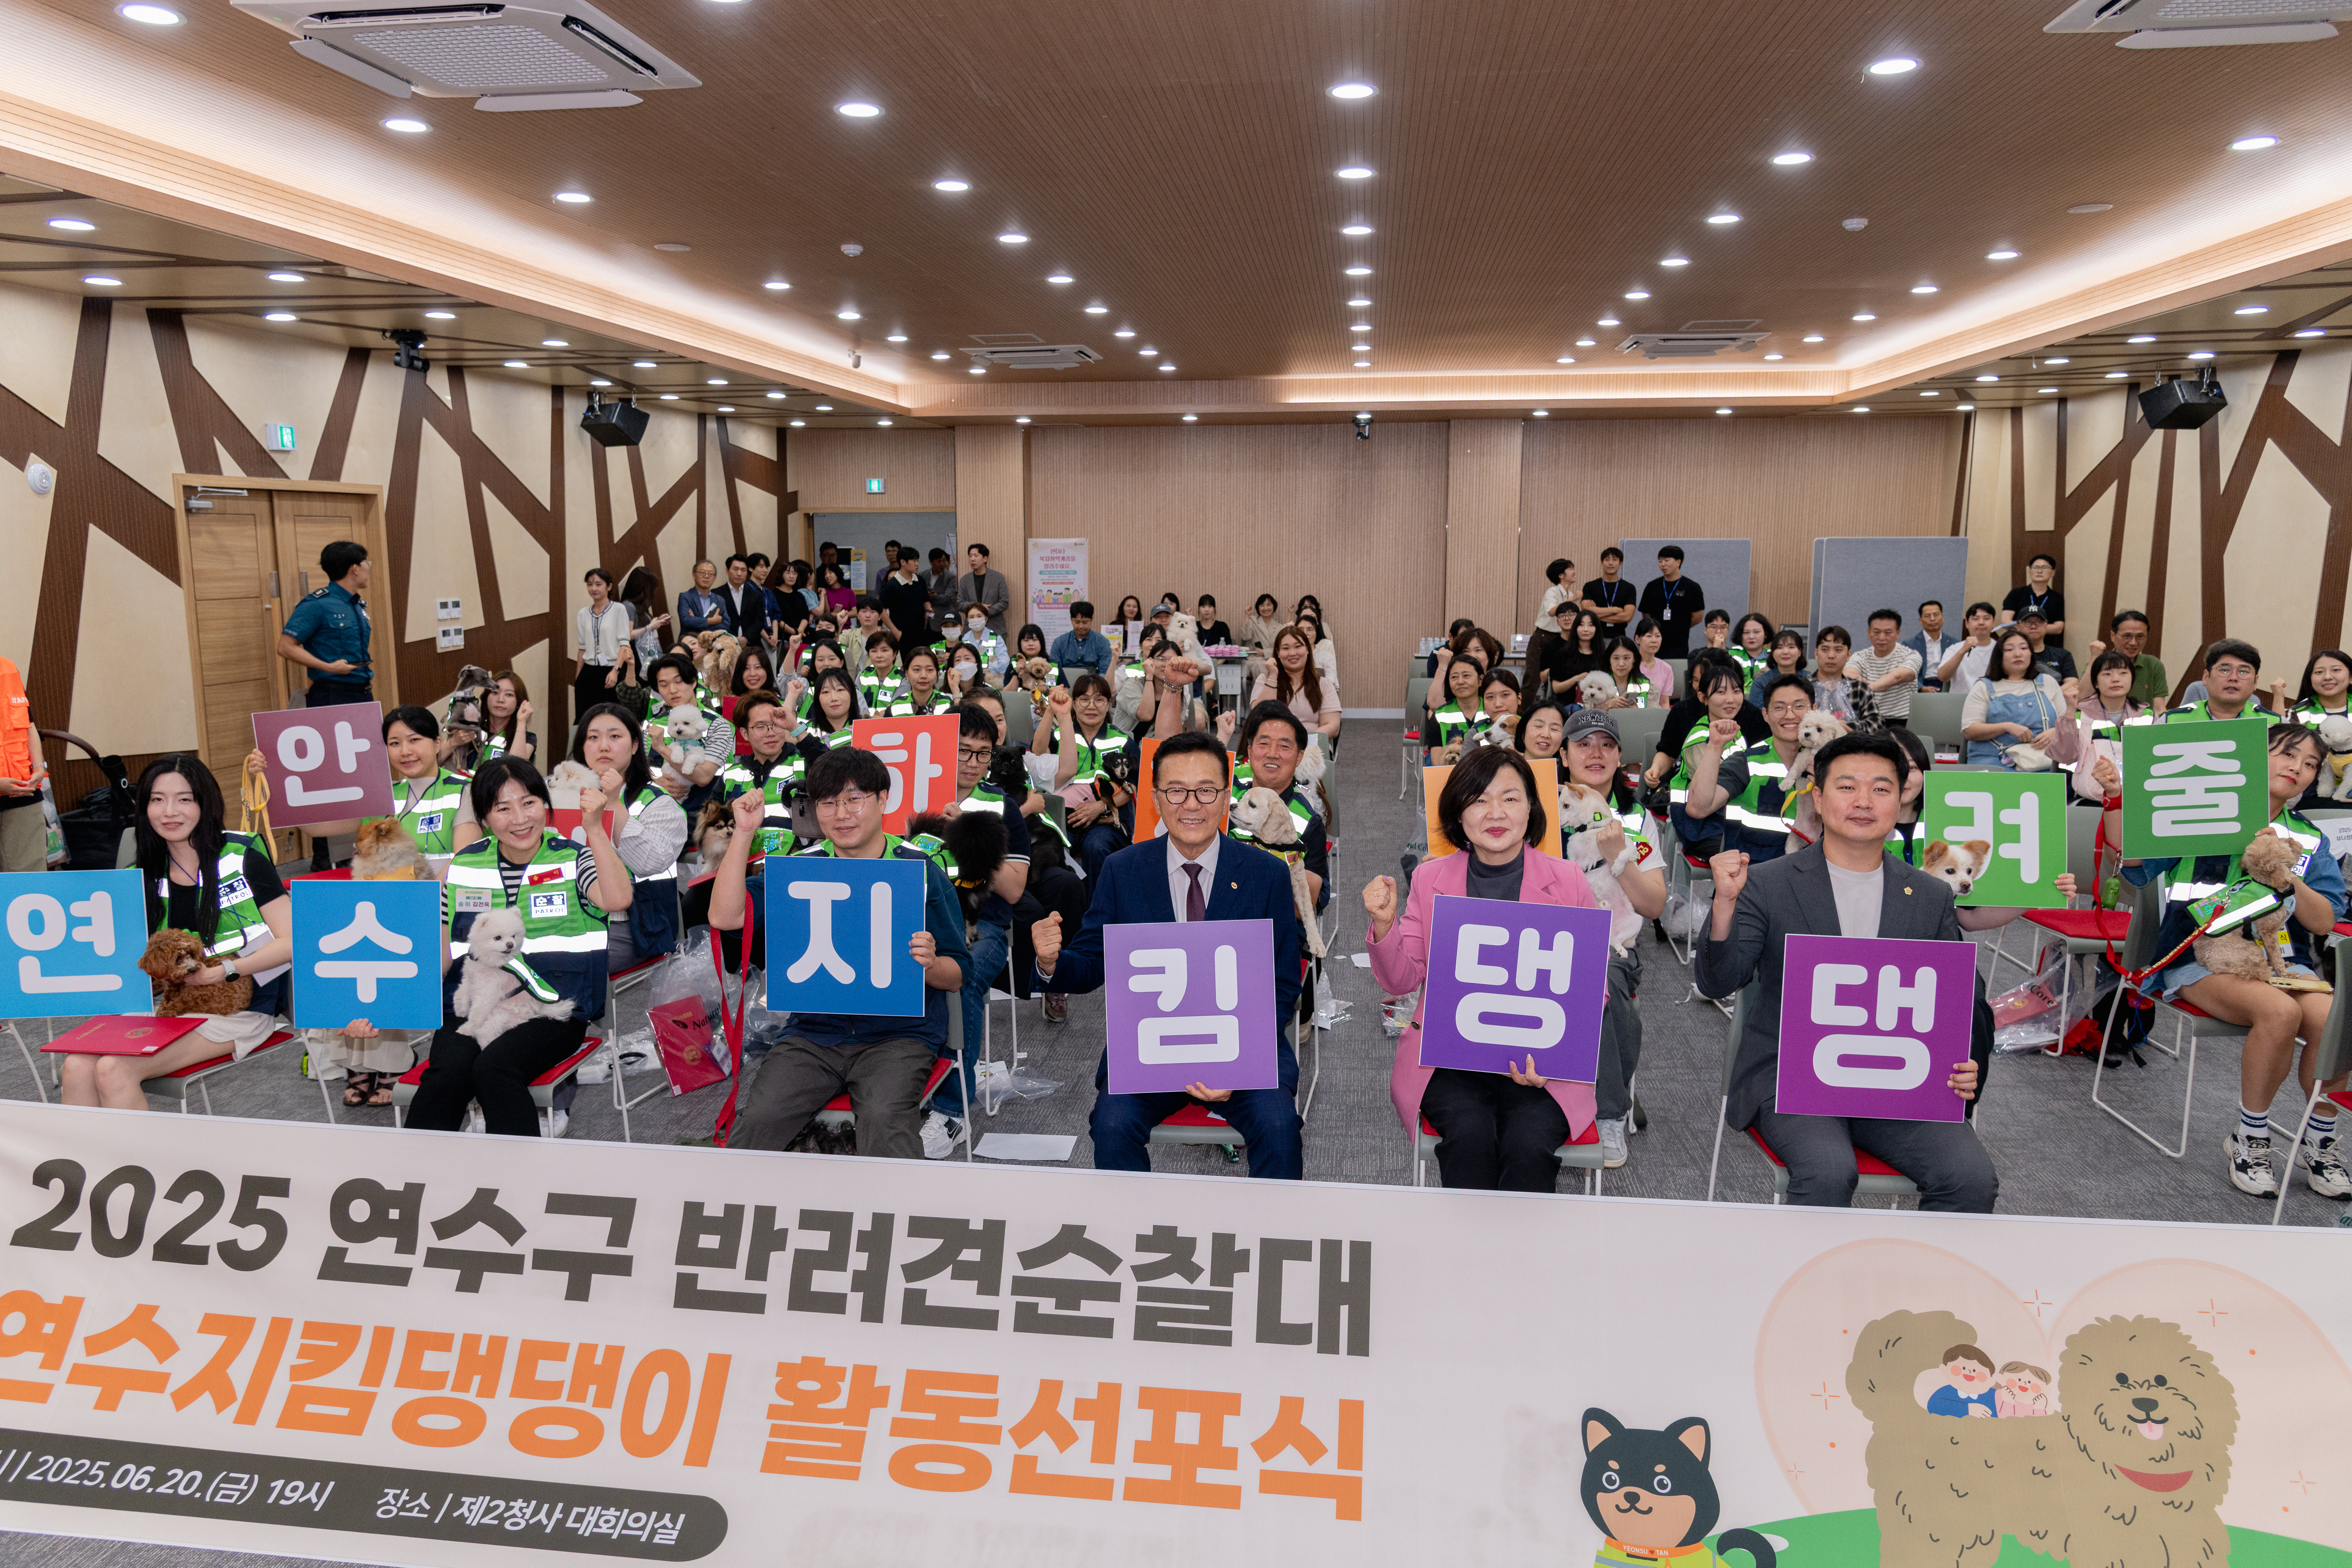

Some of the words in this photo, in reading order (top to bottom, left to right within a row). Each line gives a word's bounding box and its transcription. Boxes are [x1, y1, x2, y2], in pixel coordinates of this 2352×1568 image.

[277, 721, 371, 807] 안
[1579, 713, 1597, 725] NEW
[2143, 740, 2246, 836] 줄
[7, 891, 123, 994] 연
[536, 894, 564, 907] 순찰
[787, 881, 892, 989] 지
[314, 901, 418, 1004] 수
[1455, 924, 1574, 1049] 댕
[2031, 985, 2054, 1007] Core
[693, 1002, 722, 1030] Natural
[1128, 945, 1240, 1065] 킴
[1811, 963, 1938, 1091] 댕
[10, 1159, 291, 1272] 2025
[317, 1177, 637, 1302] 연수구
[673, 1201, 1371, 1357] 반려견순찰대
[0, 1289, 732, 1468] 연수지킴댕댕이
[760, 1355, 1364, 1521] 활동선포식
[26, 1455, 259, 1505] 2025.06.20.(금)
[267, 1479, 335, 1512] 19시
[376, 1489, 431, 1518] 장소
[453, 1495, 563, 1533] 제2청사
[565, 1506, 686, 1545] 대회의실
[1623, 1544, 1648, 1555] YEONSU
